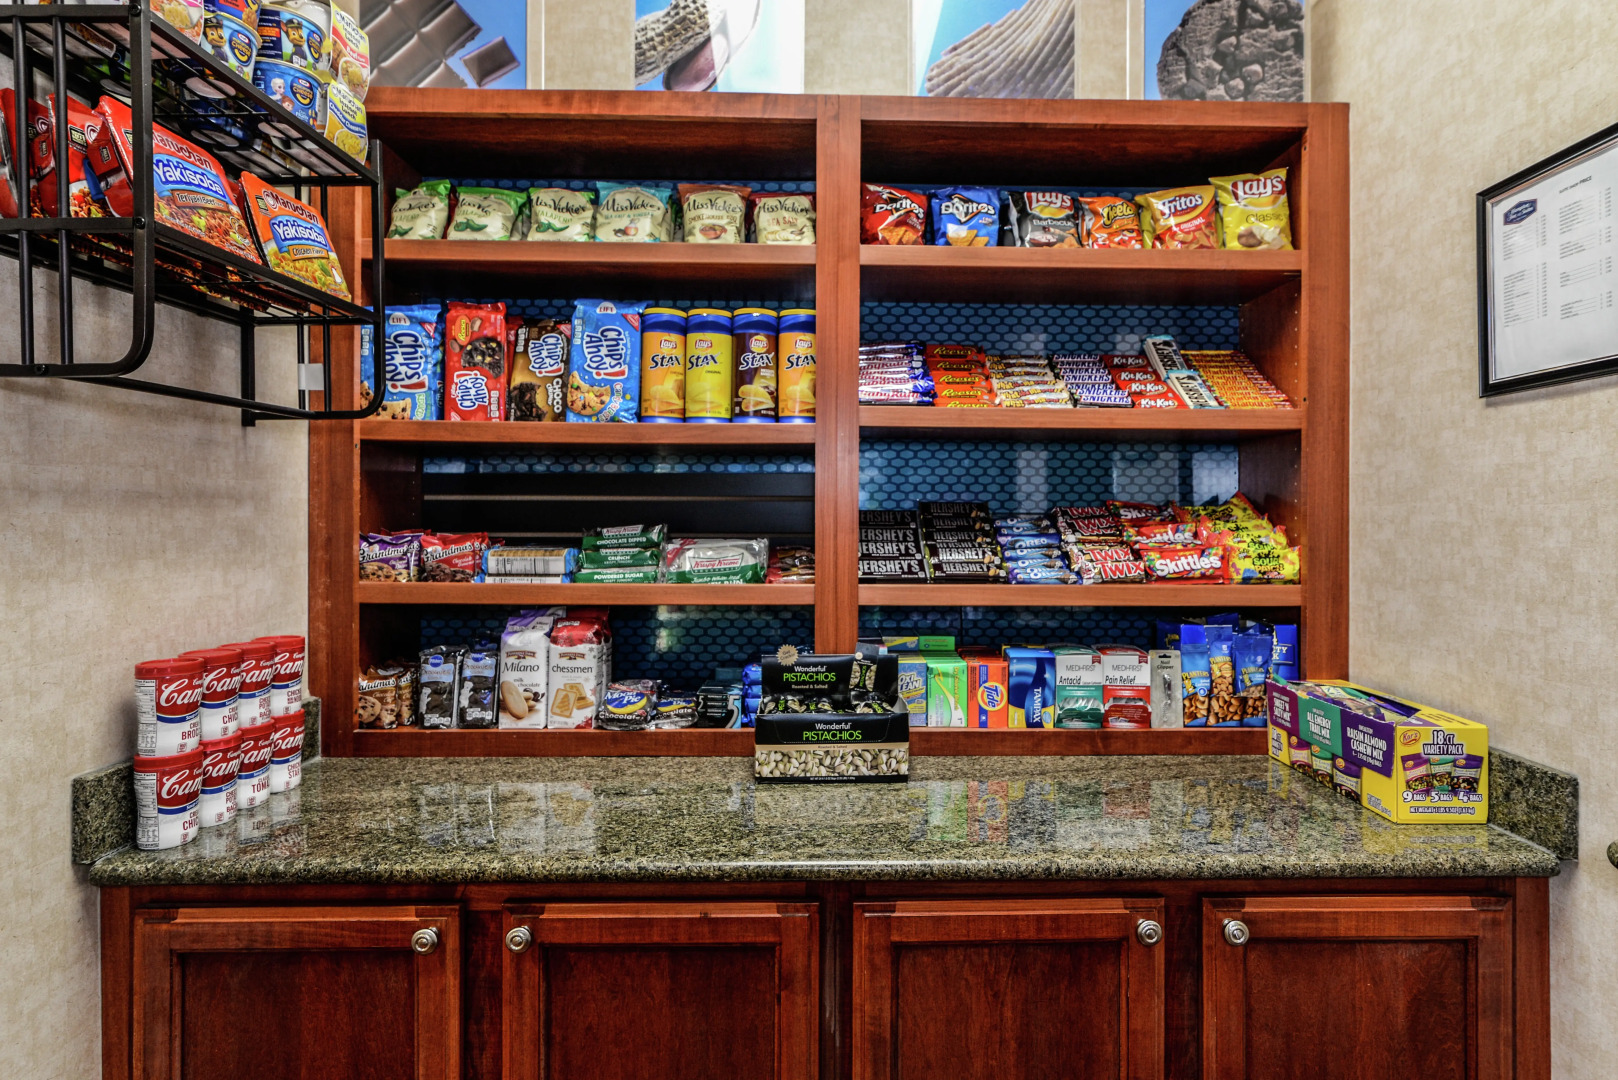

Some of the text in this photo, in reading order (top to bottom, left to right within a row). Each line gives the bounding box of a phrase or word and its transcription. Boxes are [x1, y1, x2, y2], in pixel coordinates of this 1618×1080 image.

[153, 160, 224, 195] Yakisoba
[270, 191, 319, 225] Maruchan
[601, 198, 626, 212] Miss
[686, 196, 742, 213] Miss Vickie's
[874, 200, 924, 218] Doritos
[940, 200, 996, 215] Doritos
[1160, 193, 1203, 219] Fritos
[1102, 203, 1136, 227] Cheeto
[1032, 219, 1074, 227] Barbecue
[273, 222, 327, 245] Yakisoba
[392, 331, 422, 380] Chips
[541, 335, 561, 368] Chips
[600, 328, 623, 369] Chips
[940, 375, 980, 383] Reese's
[458, 378, 477, 409] Chips
[553, 378, 562, 413] CHOCO
[941, 389, 982, 397] Reese's
[1064, 507, 1109, 516] TWIX
[1067, 516, 1117, 529] TWIX
[1015, 538, 1048, 549] OREO
[423, 542, 473, 562] Grandma's
[1085, 548, 1132, 562] TWIX
[694, 559, 739, 569] Krispy Kreme
[942, 563, 997, 572] HERSHEY'S
[1155, 555, 1222, 577] Skittles
[1253, 557, 1280, 566] SOUR
[1095, 561, 1145, 580] TWIX
[502, 661, 540, 673] Milano
[1209, 656, 1232, 664] PLANTERS
[551, 664, 593, 674] chessmen
[1181, 671, 1209, 680] PLANTERS
[783, 672, 836, 682] PISTACHIOS
[899, 674, 914, 683] OXI
[1058, 676, 1082, 685] Antacid
[1105, 676, 1136, 684] Pain Relief
[983, 685, 1000, 709] Tide
[1033, 687, 1042, 722] TAMPAX
[815, 722, 851, 730] Wonderful
[1307, 712, 1317, 723] ALL
[1317, 714, 1332, 729] ENERGY
[803, 730, 862, 741] PISTACHIOS
[1309, 721, 1321, 735] TRAIL
[1321, 726, 1331, 739] MIX
[1403, 732, 1418, 742] Kar's
[1433, 730, 1444, 744] 18
[1346, 727, 1364, 742] RAISIN
[1364, 733, 1387, 751] ALMOND
[1350, 739, 1371, 757] CASHEW
[1372, 747, 1383, 761] MIX
[1423, 744, 1464, 755] VARIETY PACK
[1402, 791, 1426, 802] 9 BAGS
[1430, 791, 1453, 802] 5 BAGS
[1458, 791, 1482, 802] 4 BAGS
